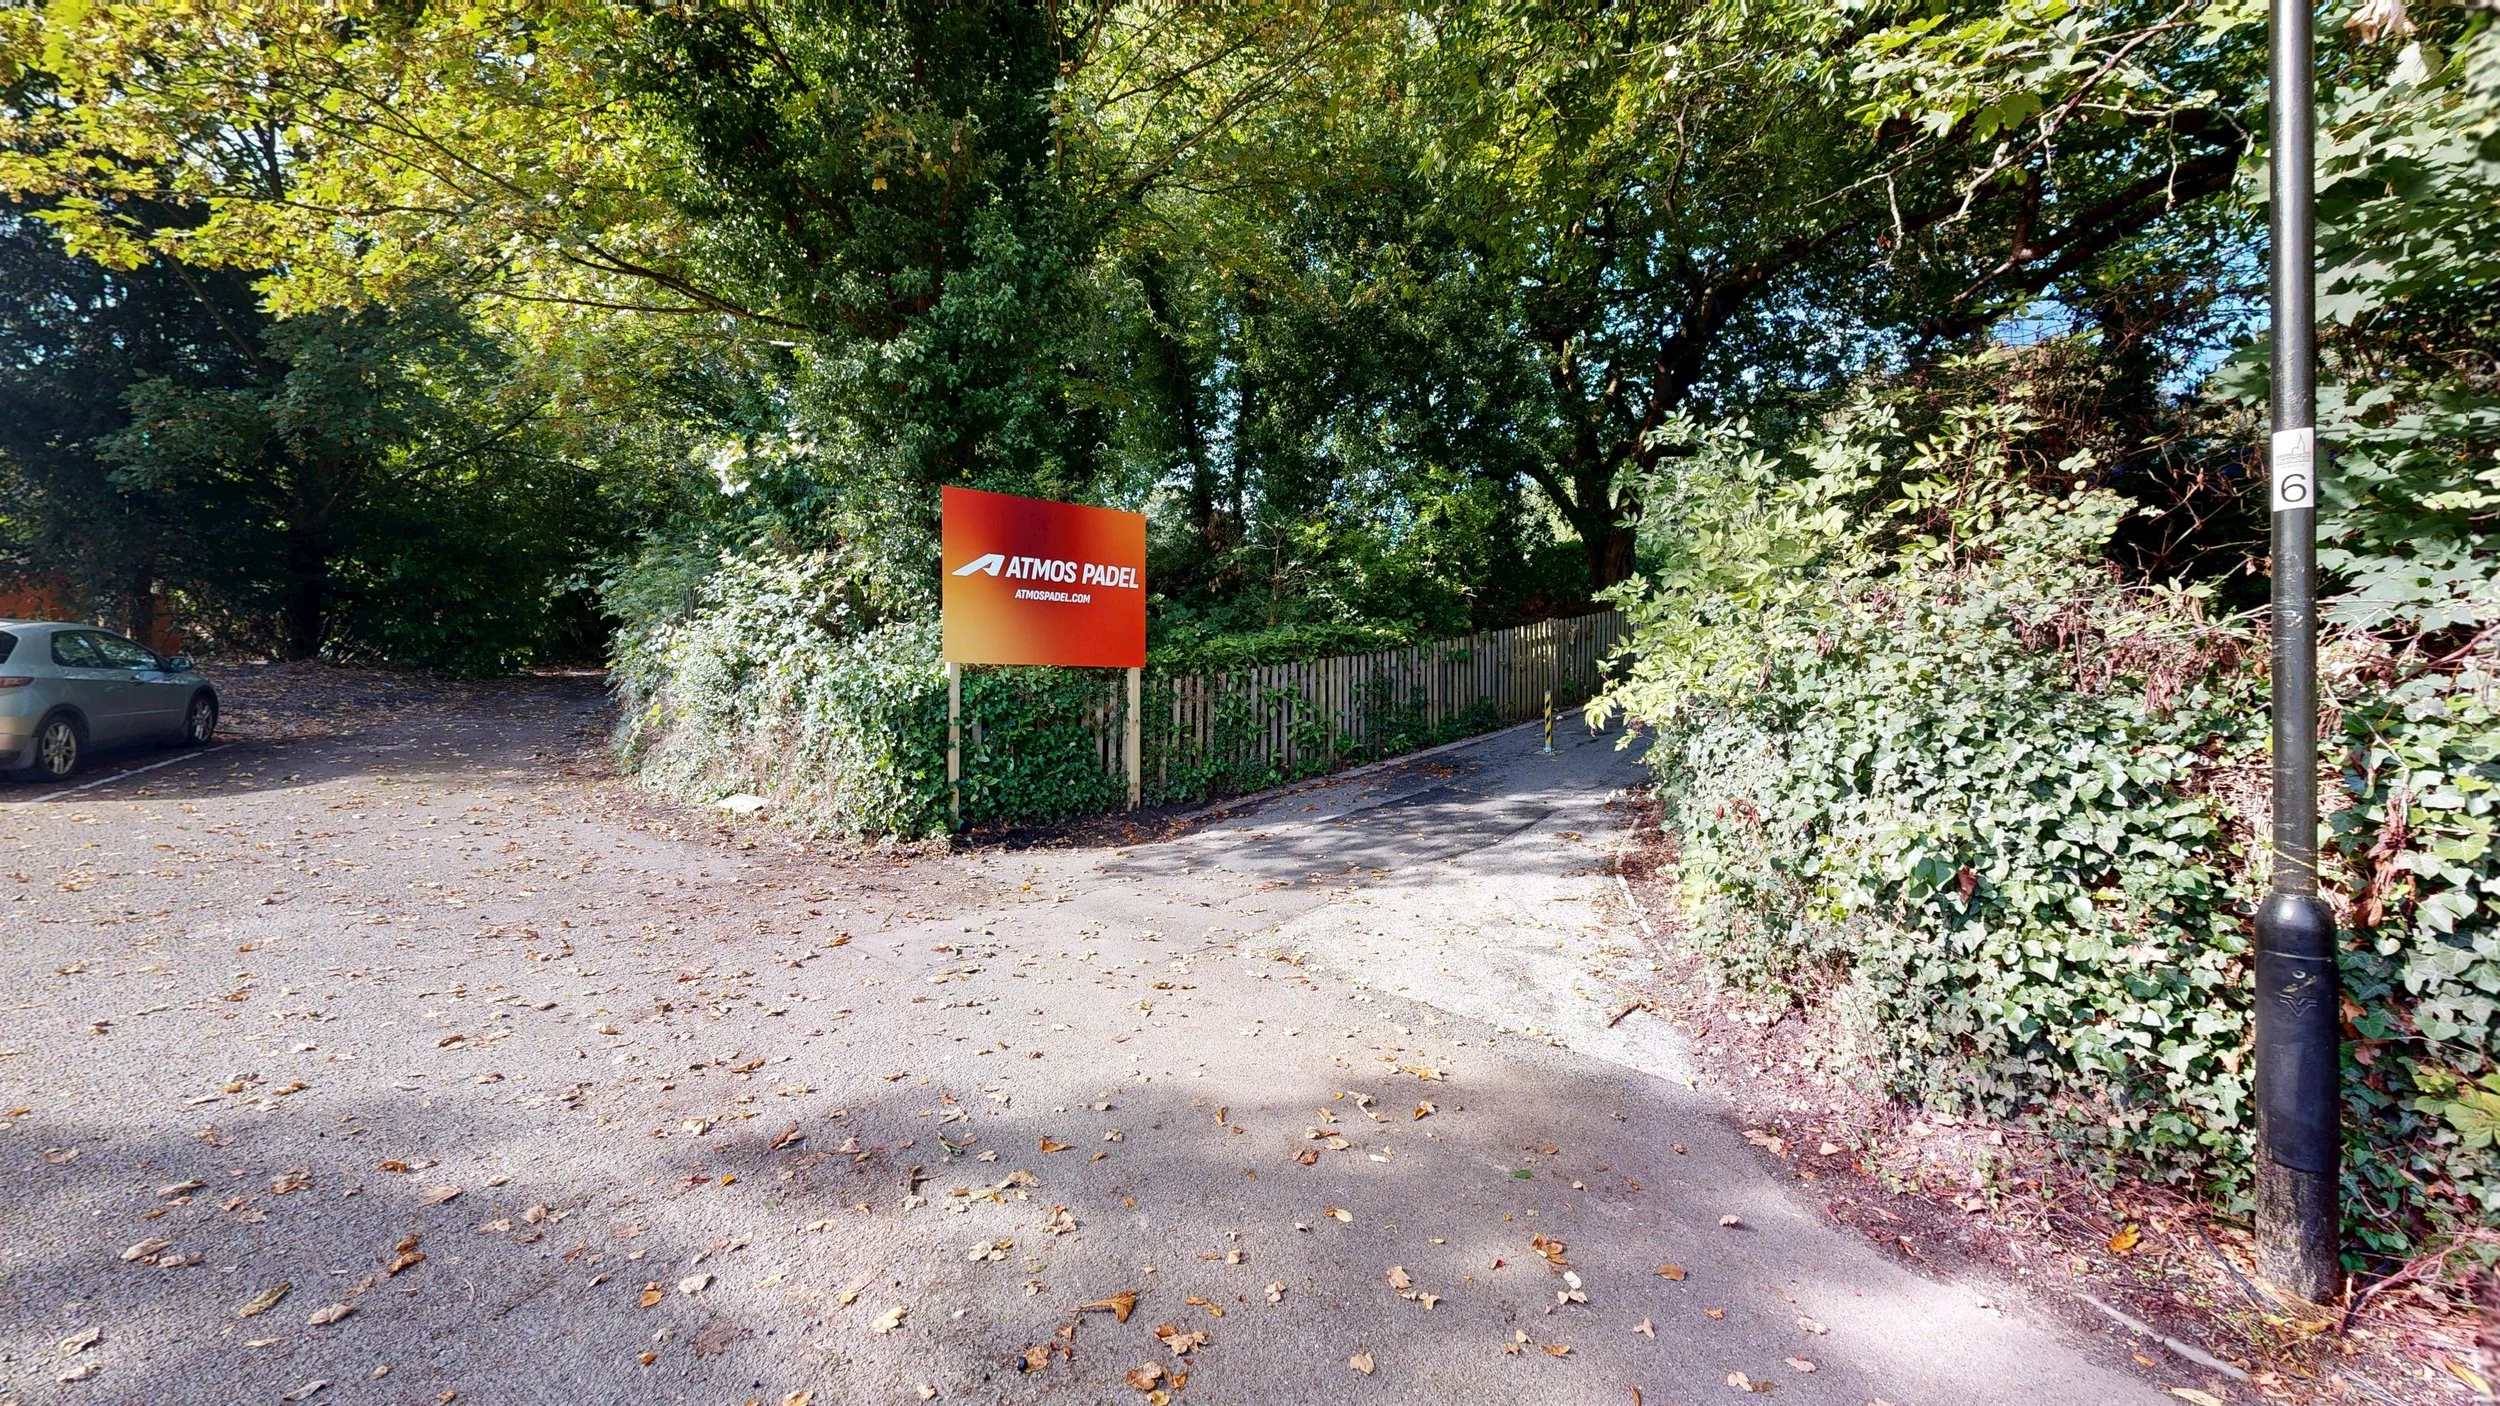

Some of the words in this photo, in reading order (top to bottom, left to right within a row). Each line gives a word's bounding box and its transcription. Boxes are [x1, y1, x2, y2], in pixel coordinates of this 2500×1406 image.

[2281, 473, 2307, 502] 6
[1005, 556, 1078, 583] ATMOS
[1082, 563, 1139, 589] PADEL
[1015, 589, 1091, 604] ATMOSPADEL.COM
